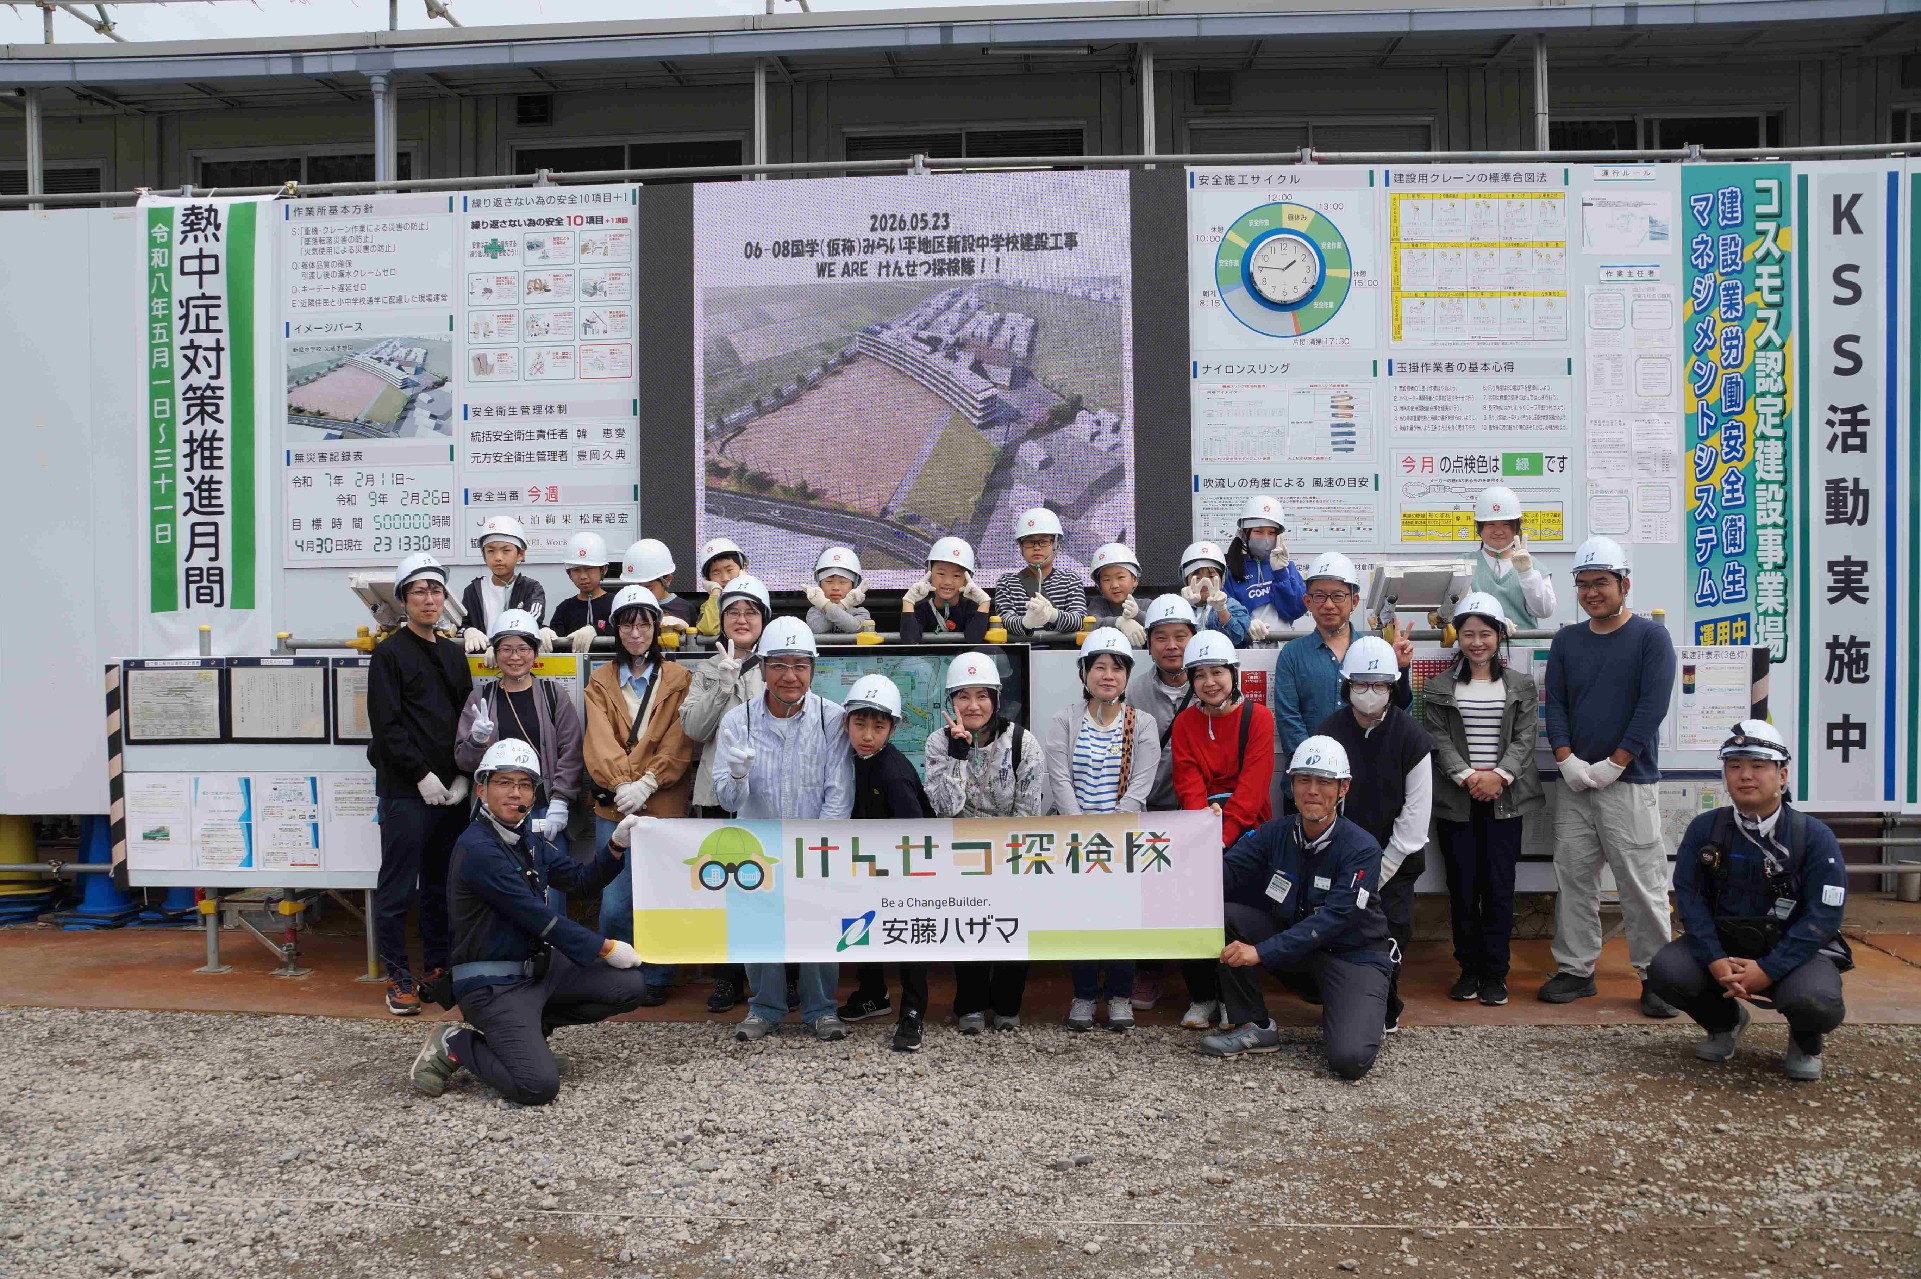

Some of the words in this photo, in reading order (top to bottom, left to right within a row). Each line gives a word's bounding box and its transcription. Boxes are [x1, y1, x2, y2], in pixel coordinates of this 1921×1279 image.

[1198, 174, 1301, 186] 安全施工サイクル
[1394, 172, 1548, 184] 建設用クレーンの標準合図法
[293, 203, 374, 217] 作業所基本方針
[870, 213, 951, 232] 2026.05.23
[1196, 234, 1221, 243] 10:00
[816, 261, 837, 279] WE
[841, 260, 868, 278] ARE
[1606, 270, 1655, 278] 作業主任者
[1202, 363, 1291, 375] ナイロンスリング
[1397, 361, 1515, 373] 玉掛作業者の基本心得
[1690, 194, 1718, 606] マネジメントシステム
[1718, 186, 1746, 600] 建設業労働安全衛生
[178, 203, 226, 610] 熱中症対策推進月間
[472, 404, 568, 418] 安全衛生管理体制
[1753, 179, 1786, 660] コスモス認定建設事業場
[470, 429, 569, 443] 統括安全衛生責任者
[294, 451, 363, 463] 無災害記録表
[470, 450, 569, 464] 元方安全衛生管理者
[292, 476, 312, 488] 令和
[1203, 477, 1305, 489] 吹流しの角度による
[1312, 477, 1369, 488] 風速の目安
[336, 494, 357, 506] 令和
[472, 490, 519, 502] 安全当番
[527, 485, 559, 503] 今週
[292, 517, 363, 530] 目標時間
[579, 512, 629, 525] 松尾昭宏
[1699, 617, 1747, 646] 運用中
[795, 831, 1173, 878] けんせつ探検隊
[881, 898, 895, 908] Be
[897, 900, 904, 908] a
[906, 897, 992, 909] ChangeBuilder.
[881, 914, 1019, 945] 安藤ハザマ
